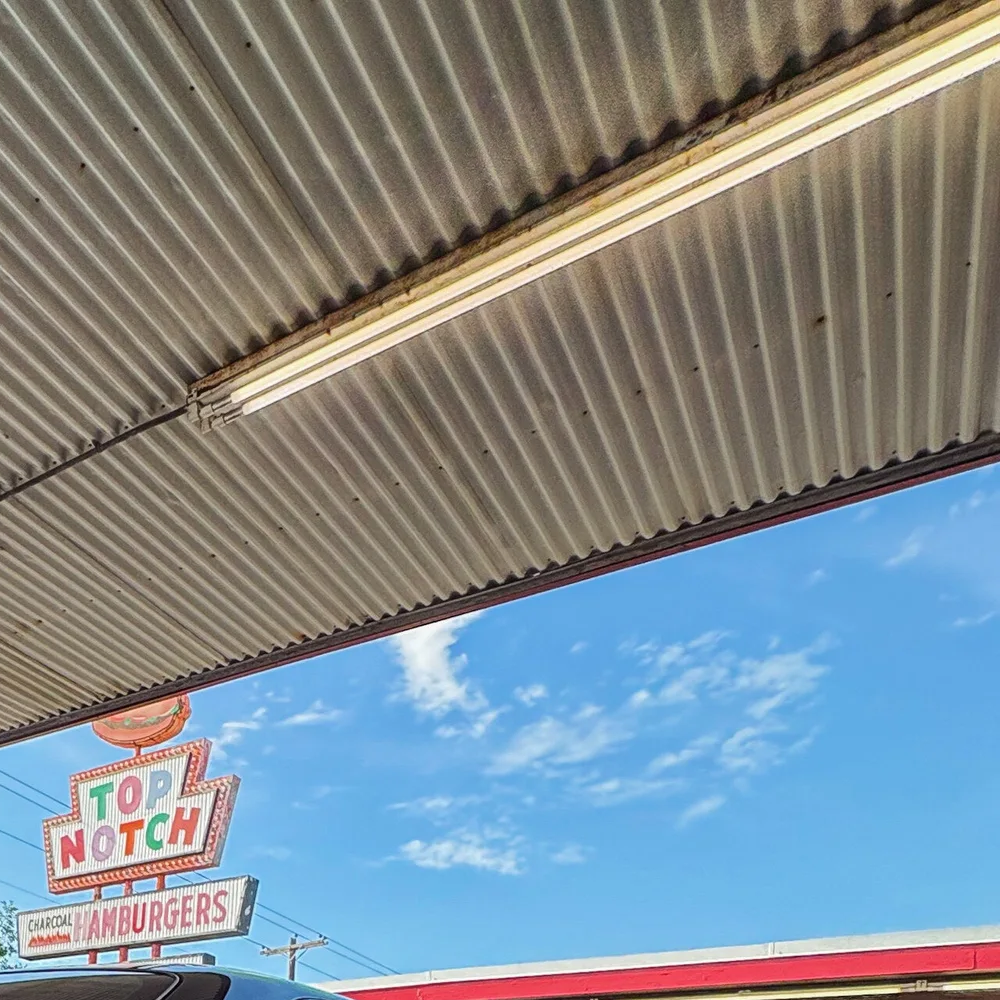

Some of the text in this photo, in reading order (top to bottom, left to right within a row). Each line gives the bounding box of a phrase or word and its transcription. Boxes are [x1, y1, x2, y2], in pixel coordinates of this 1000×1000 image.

[90, 769, 173, 820] TOP
[60, 806, 202, 869] NOTCH
[28, 889, 229, 942] CHARCOAL HAMBURGERS
